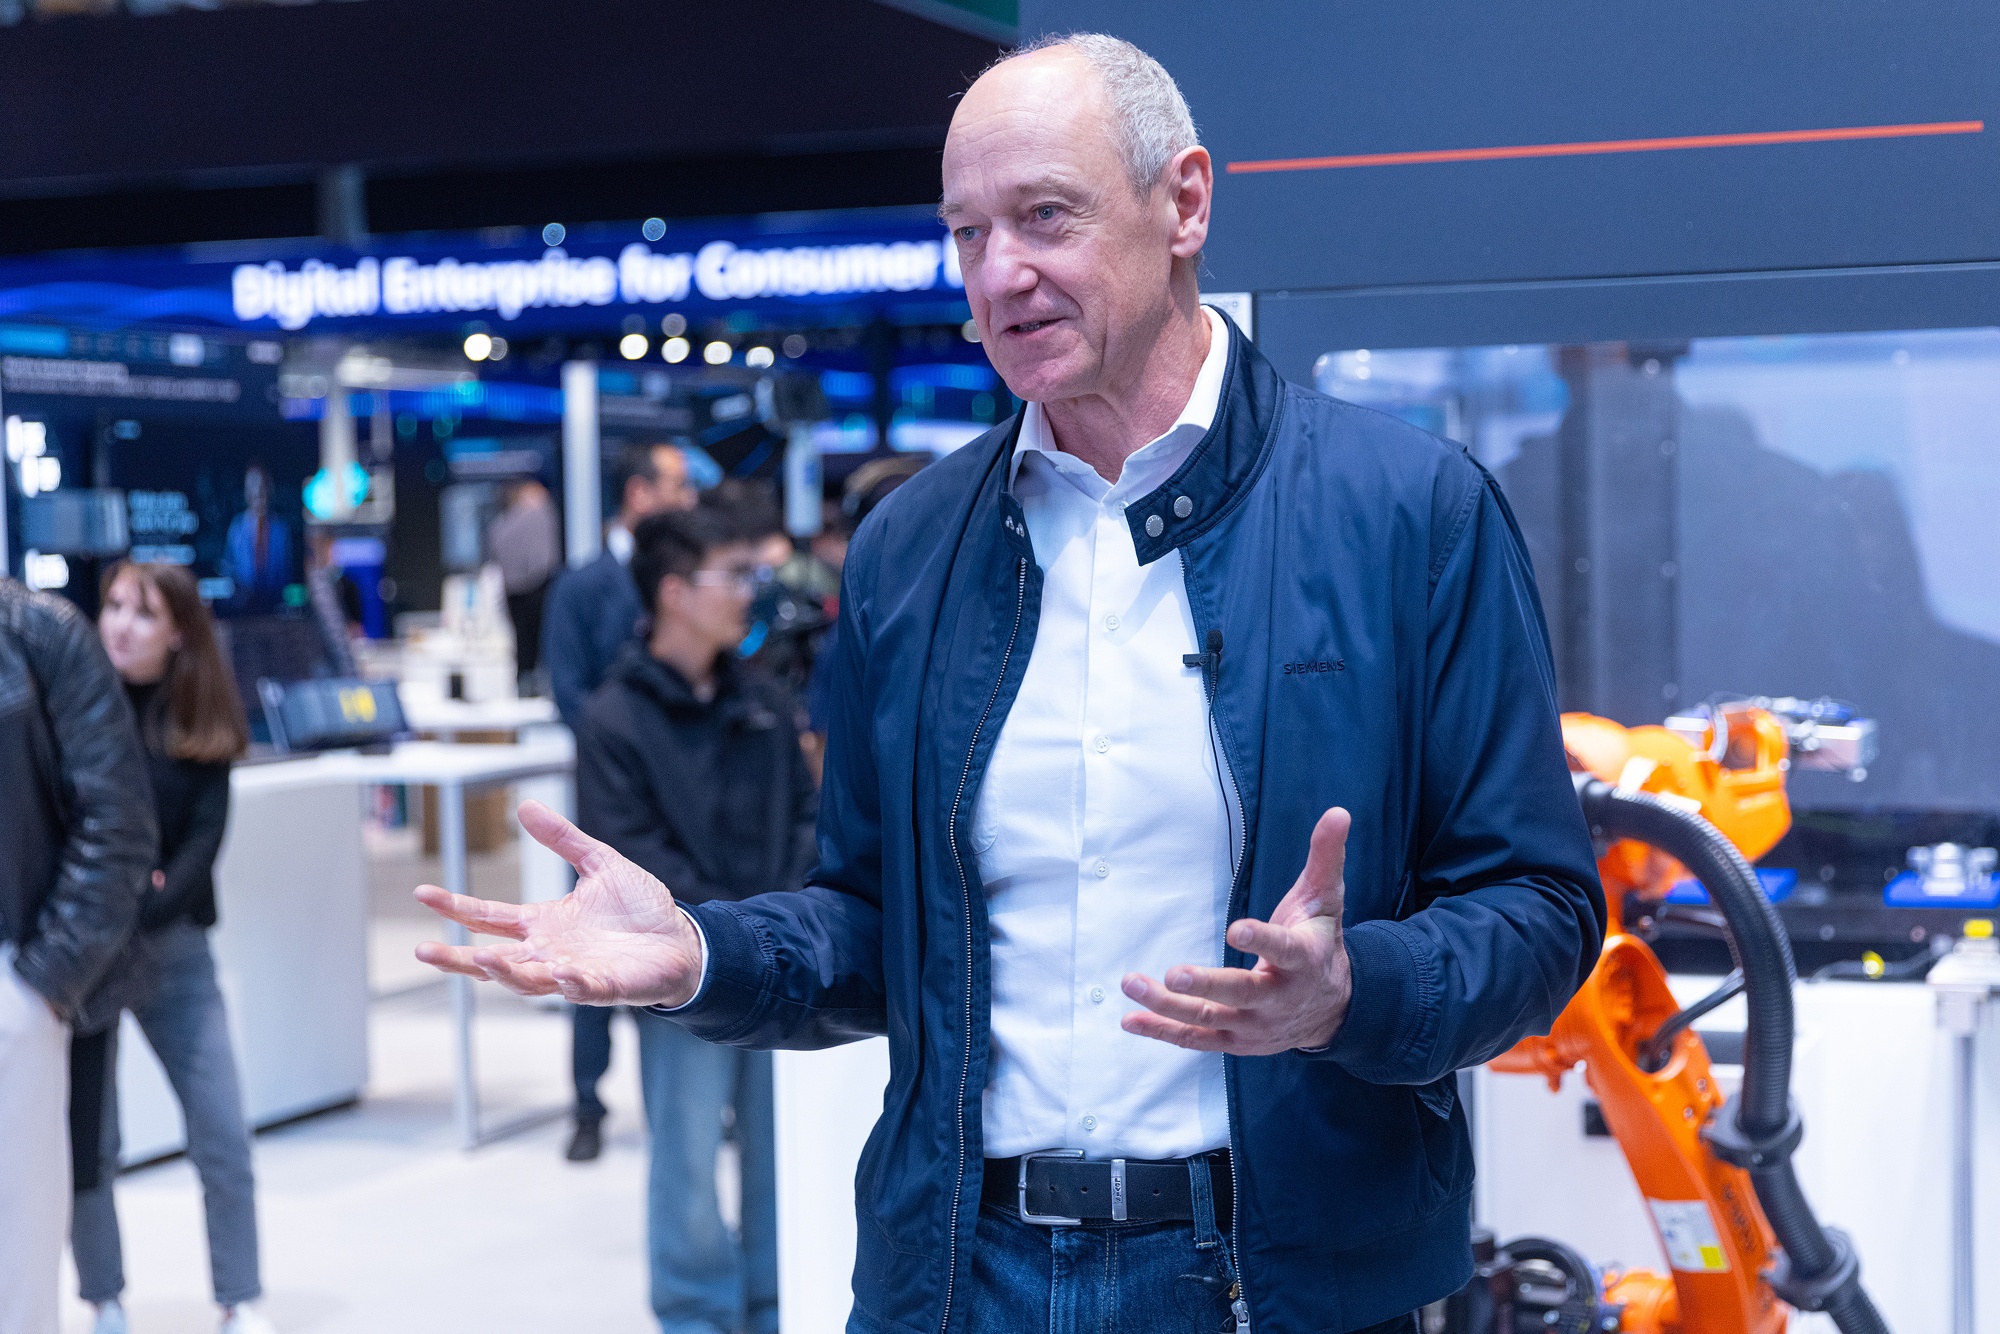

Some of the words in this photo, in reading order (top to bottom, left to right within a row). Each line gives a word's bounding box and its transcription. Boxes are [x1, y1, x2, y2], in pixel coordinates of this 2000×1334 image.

[233, 260, 380, 329] Digital
[382, 247, 617, 320] Enterprise
[618, 243, 692, 303] for
[694, 240, 943, 300] Consumer
[1283, 659, 1346, 675] SIEMENS
